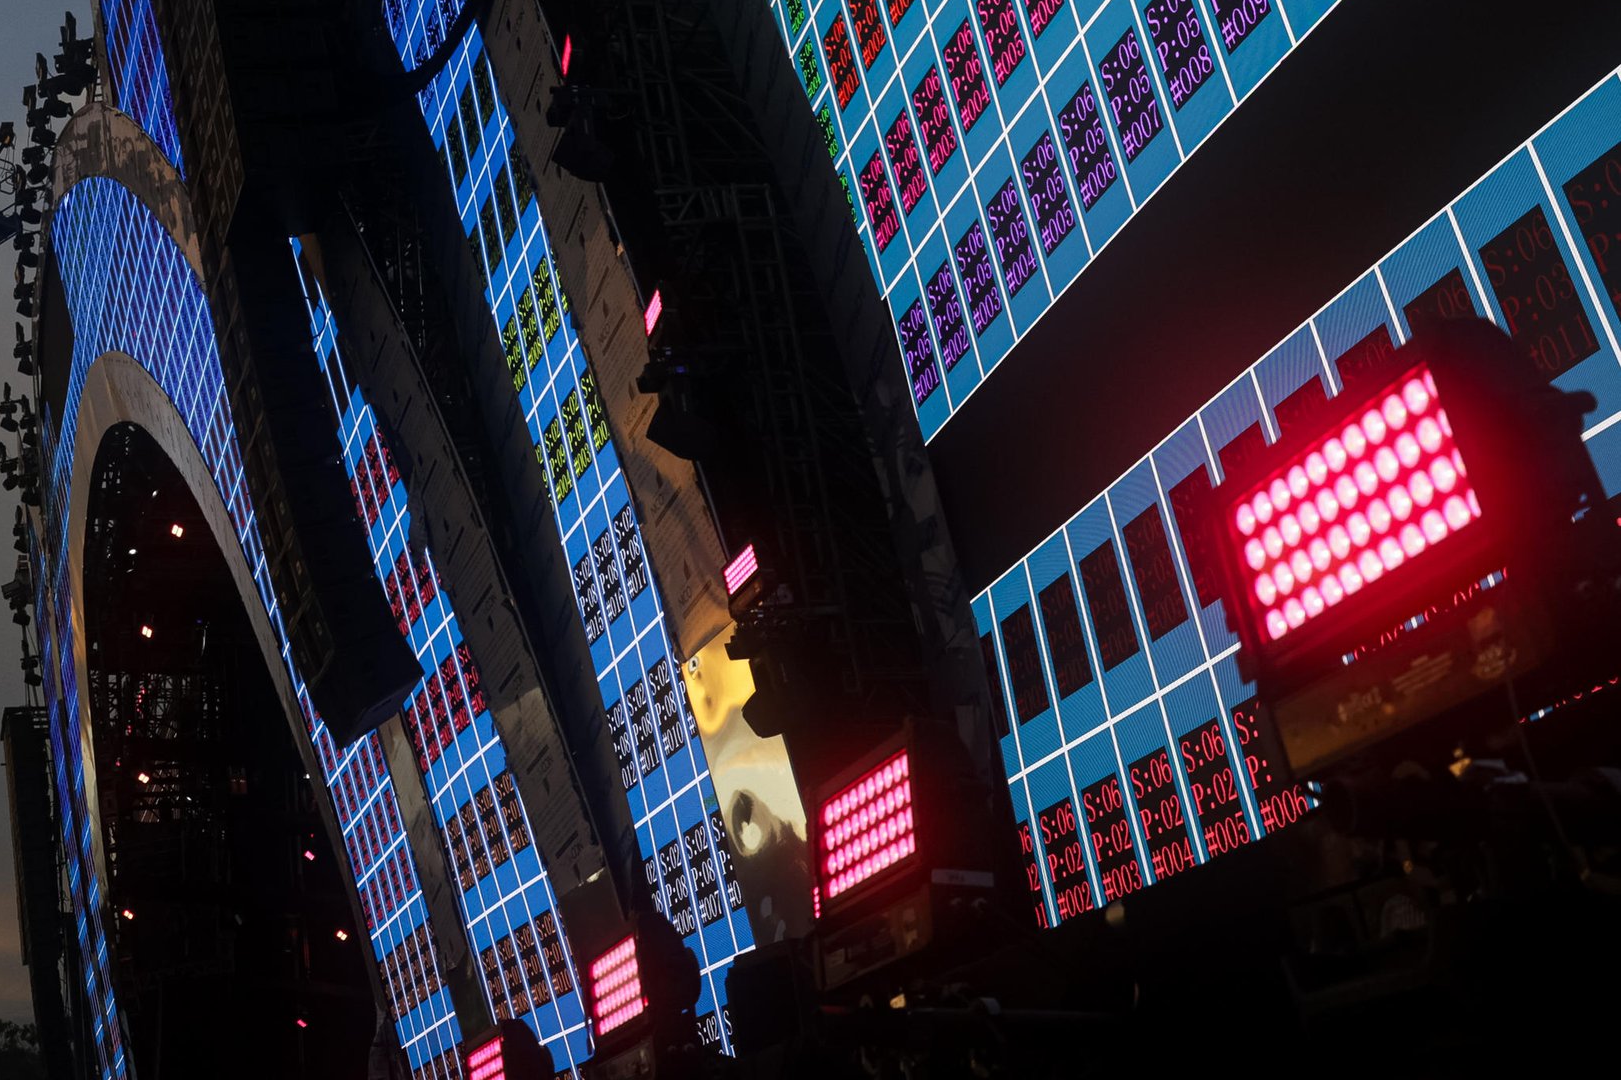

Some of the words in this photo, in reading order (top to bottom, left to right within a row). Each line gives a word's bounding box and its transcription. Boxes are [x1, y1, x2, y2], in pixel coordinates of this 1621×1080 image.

[945, 23, 972, 72] S:06
[1101, 33, 1139, 91] S:06
[952, 51, 980, 102] P:06
[1111, 65, 1150, 126] P:05
[961, 81, 989, 130] #004
[1123, 99, 1158, 158] #007
[1023, 136, 1054, 188] S:06
[1031, 167, 1064, 220] P:05
[1042, 200, 1073, 252] #005
[957, 225, 984, 272] S:06
[1483, 214, 1553, 287] S:06
[964, 254, 992, 302] P:05
[973, 287, 1000, 332] #003
[614, 506, 634, 543] S:02
[593, 532, 612, 567] S:02
[619, 534, 641, 571] P:08
[599, 559, 619, 595] P:08
[627, 562, 646, 598] #017
[606, 587, 625, 623] #016
[649, 661, 670, 695] S:02
[654, 691, 677, 726] P:08
[662, 721, 684, 755] #010
[1181, 725, 1225, 773] S:06
[1130, 753, 1172, 799] S:06
[1191, 768, 1238, 816] P:02
[1083, 779, 1122, 822] S:06
[1140, 795, 1184, 840] P:02
[685, 825, 708, 859] S:02
[1040, 803, 1076, 844] S:06
[1092, 820, 1133, 862] P:02
[1204, 811, 1250, 858] #005
[691, 858, 715, 892] P:08
[1048, 842, 1085, 882] P:02
[1152, 836, 1196, 880] #004
[1057, 881, 1094, 920] #002
[1103, 860, 1143, 902] #003
[699, 890, 722, 923] #007
